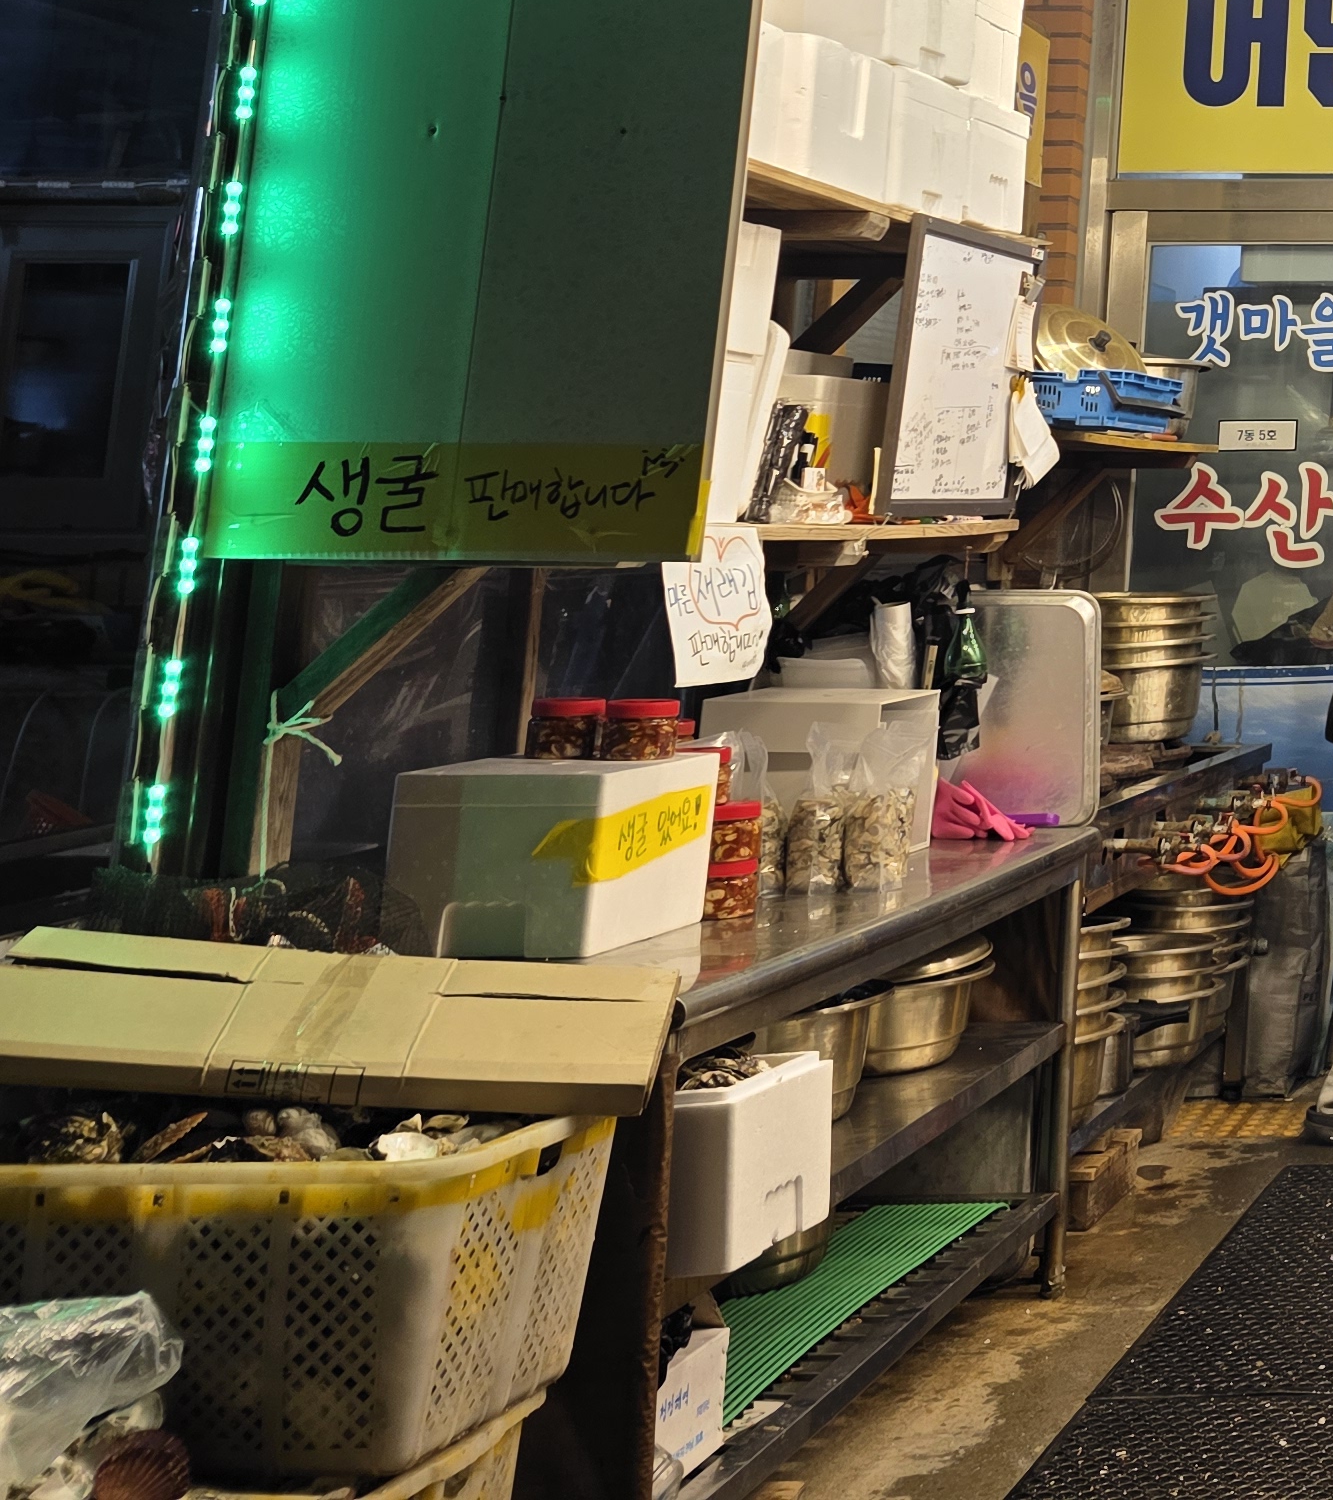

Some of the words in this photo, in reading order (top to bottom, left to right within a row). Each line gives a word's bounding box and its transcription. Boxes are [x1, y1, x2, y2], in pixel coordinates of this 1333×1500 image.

[1237, 429, 1255, 442] 7동
[1258, 429, 1277, 441] 5호
[294, 454, 439, 537] 생굴
[464, 467, 655, 521] 판매합니다
[617, 811, 648, 861] 생굴
[657, 794, 702, 846] 있어요!
